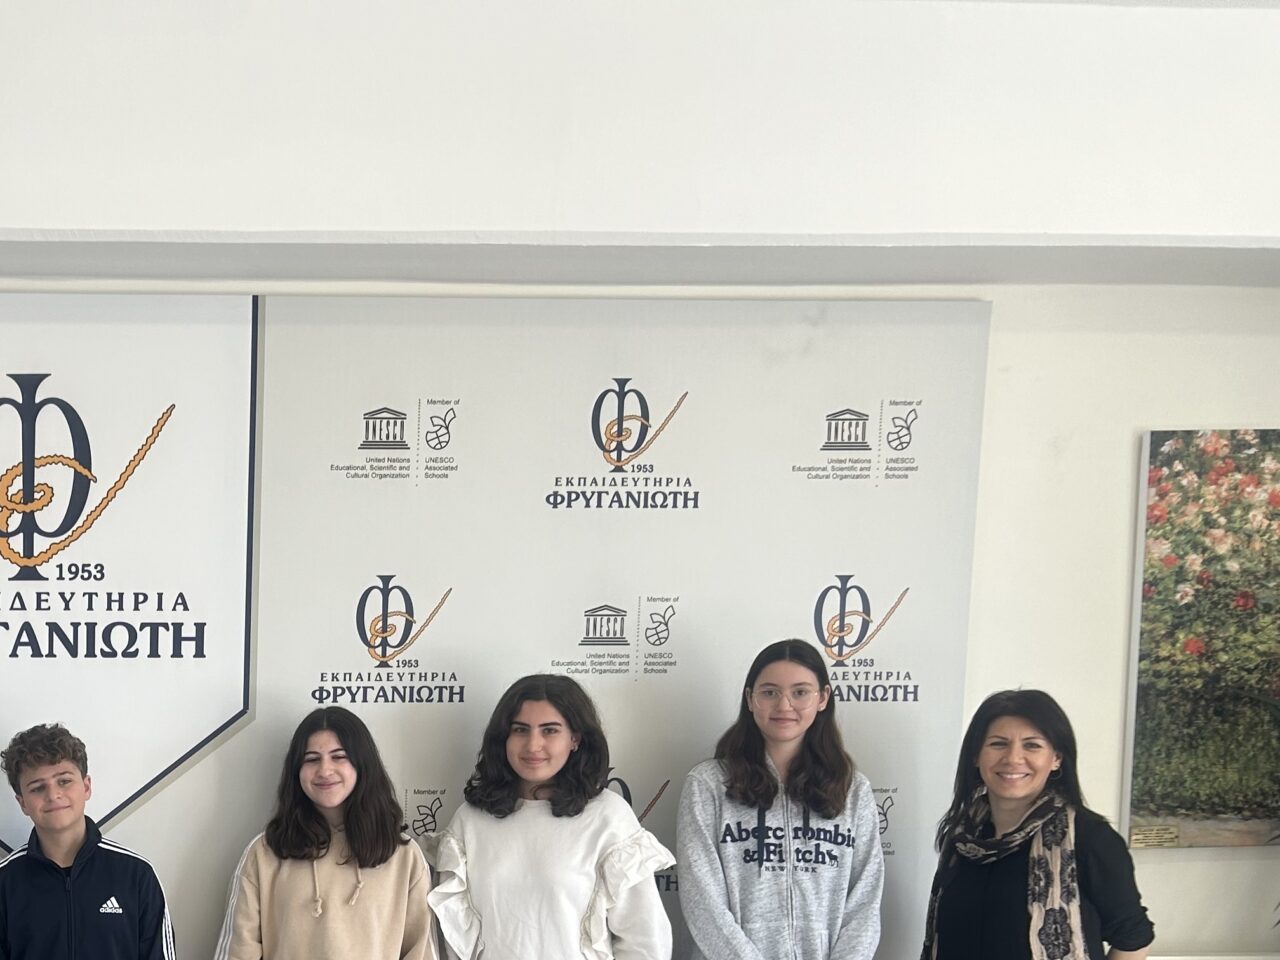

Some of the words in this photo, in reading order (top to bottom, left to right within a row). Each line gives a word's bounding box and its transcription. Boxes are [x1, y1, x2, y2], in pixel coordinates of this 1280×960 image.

[365, 420, 404, 440] UNESCO
[827, 421, 867, 442] UNESCO
[631, 464, 654, 473] 1953
[554, 476, 692, 488] ΕΚΠΑΙΔΕΥΤΗΡΙΑ
[545, 490, 699, 509] ΦΡΥΓΑΝΙΩΤΗ
[55, 563, 105, 581] 1953
[586, 617, 625, 637] UNESCO
[396, 659, 419, 668] 1953
[852, 658, 875, 667] 1953
[320, 672, 457, 683] ΕΚΠΑΙΔΕΥΤΗΡΙΑ
[830, 671, 912, 681] ΔΕΥΤΗΡΙΑ
[311, 685, 465, 704] ΦΡΥΓΑΝΙΩΤΗ
[832, 684, 919, 702] ΑΝΙΩΤΗ
[743, 849, 758, 863] &
[764, 843, 826, 864] Fitch
